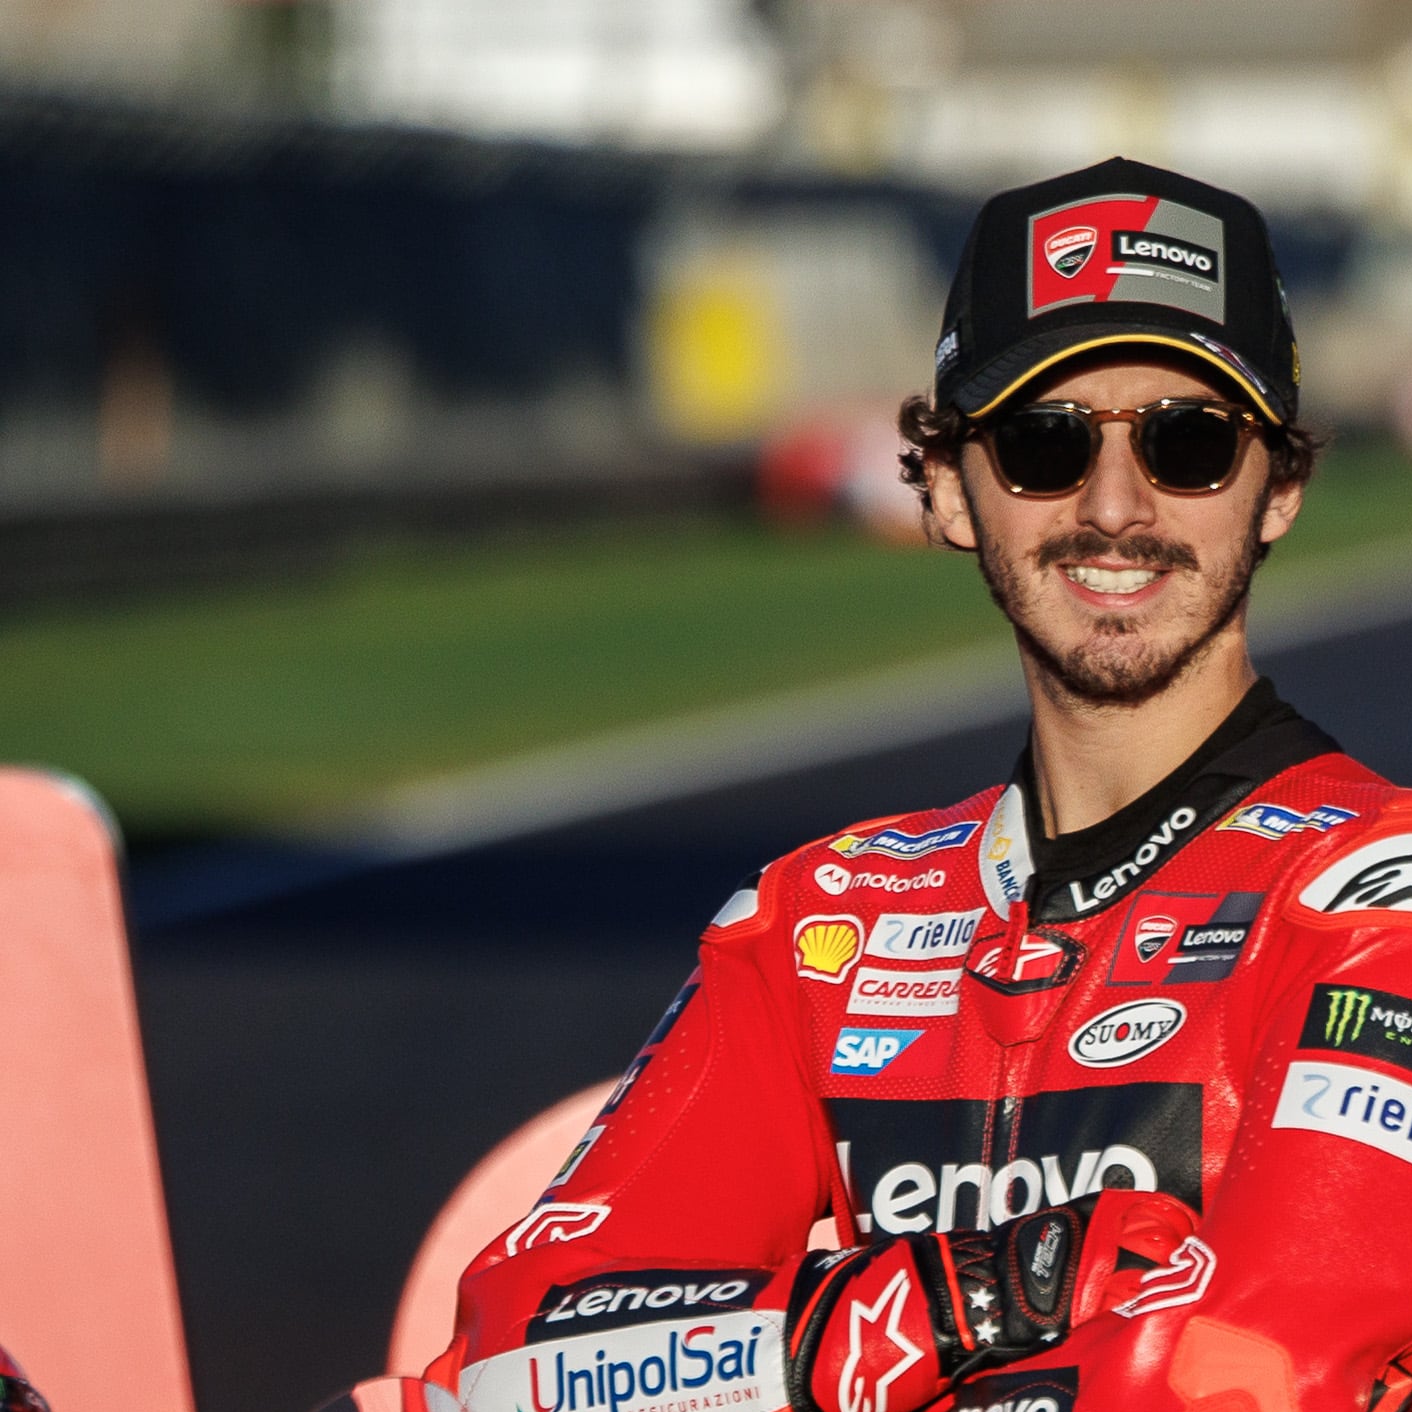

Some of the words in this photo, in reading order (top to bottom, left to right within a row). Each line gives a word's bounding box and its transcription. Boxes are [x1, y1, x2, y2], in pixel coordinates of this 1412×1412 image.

[1120, 236, 1212, 271] Lenovo
[1070, 805, 1197, 913] Lenovo
[849, 867, 946, 894] motorola
[908, 917, 975, 949] riello
[1183, 928, 1246, 946] Lenovo
[857, 979, 960, 999] CARRERA
[1083, 1018, 1174, 1047] SUOMY
[834, 1035, 898, 1068] SAP
[836, 1140, 1159, 1236] Lenovo
[545, 1280, 750, 1323] Lenovo
